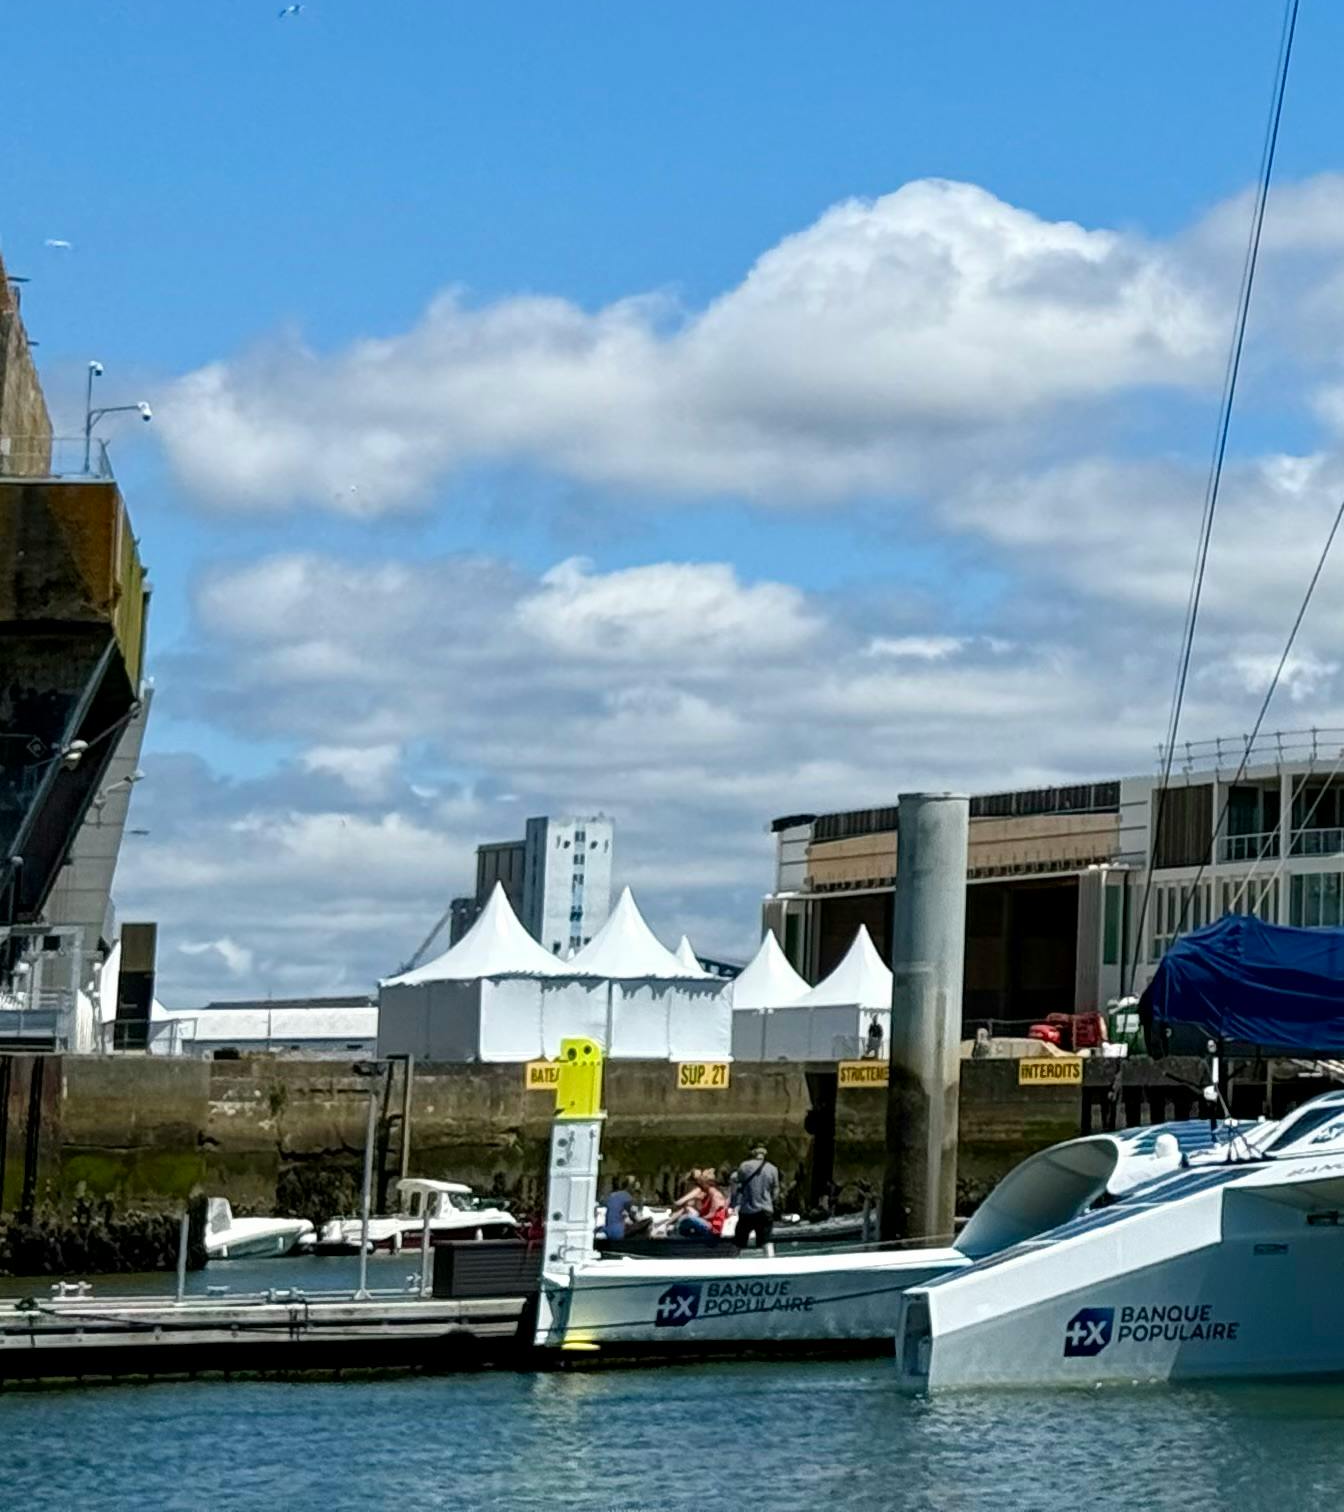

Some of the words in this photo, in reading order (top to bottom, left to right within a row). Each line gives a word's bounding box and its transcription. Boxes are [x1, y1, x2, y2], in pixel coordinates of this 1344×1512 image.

[531, 1066, 560, 1083] BATE
[712, 1065, 726, 1085] 2T
[1021, 1062, 1081, 1080] INTERDITS
[707, 1281, 791, 1298] BANQUE
[704, 1296, 815, 1314] POPULAIRE
[1121, 1305, 1212, 1323] BANQUE
[1118, 1322, 1240, 1343] POPULAIRE
